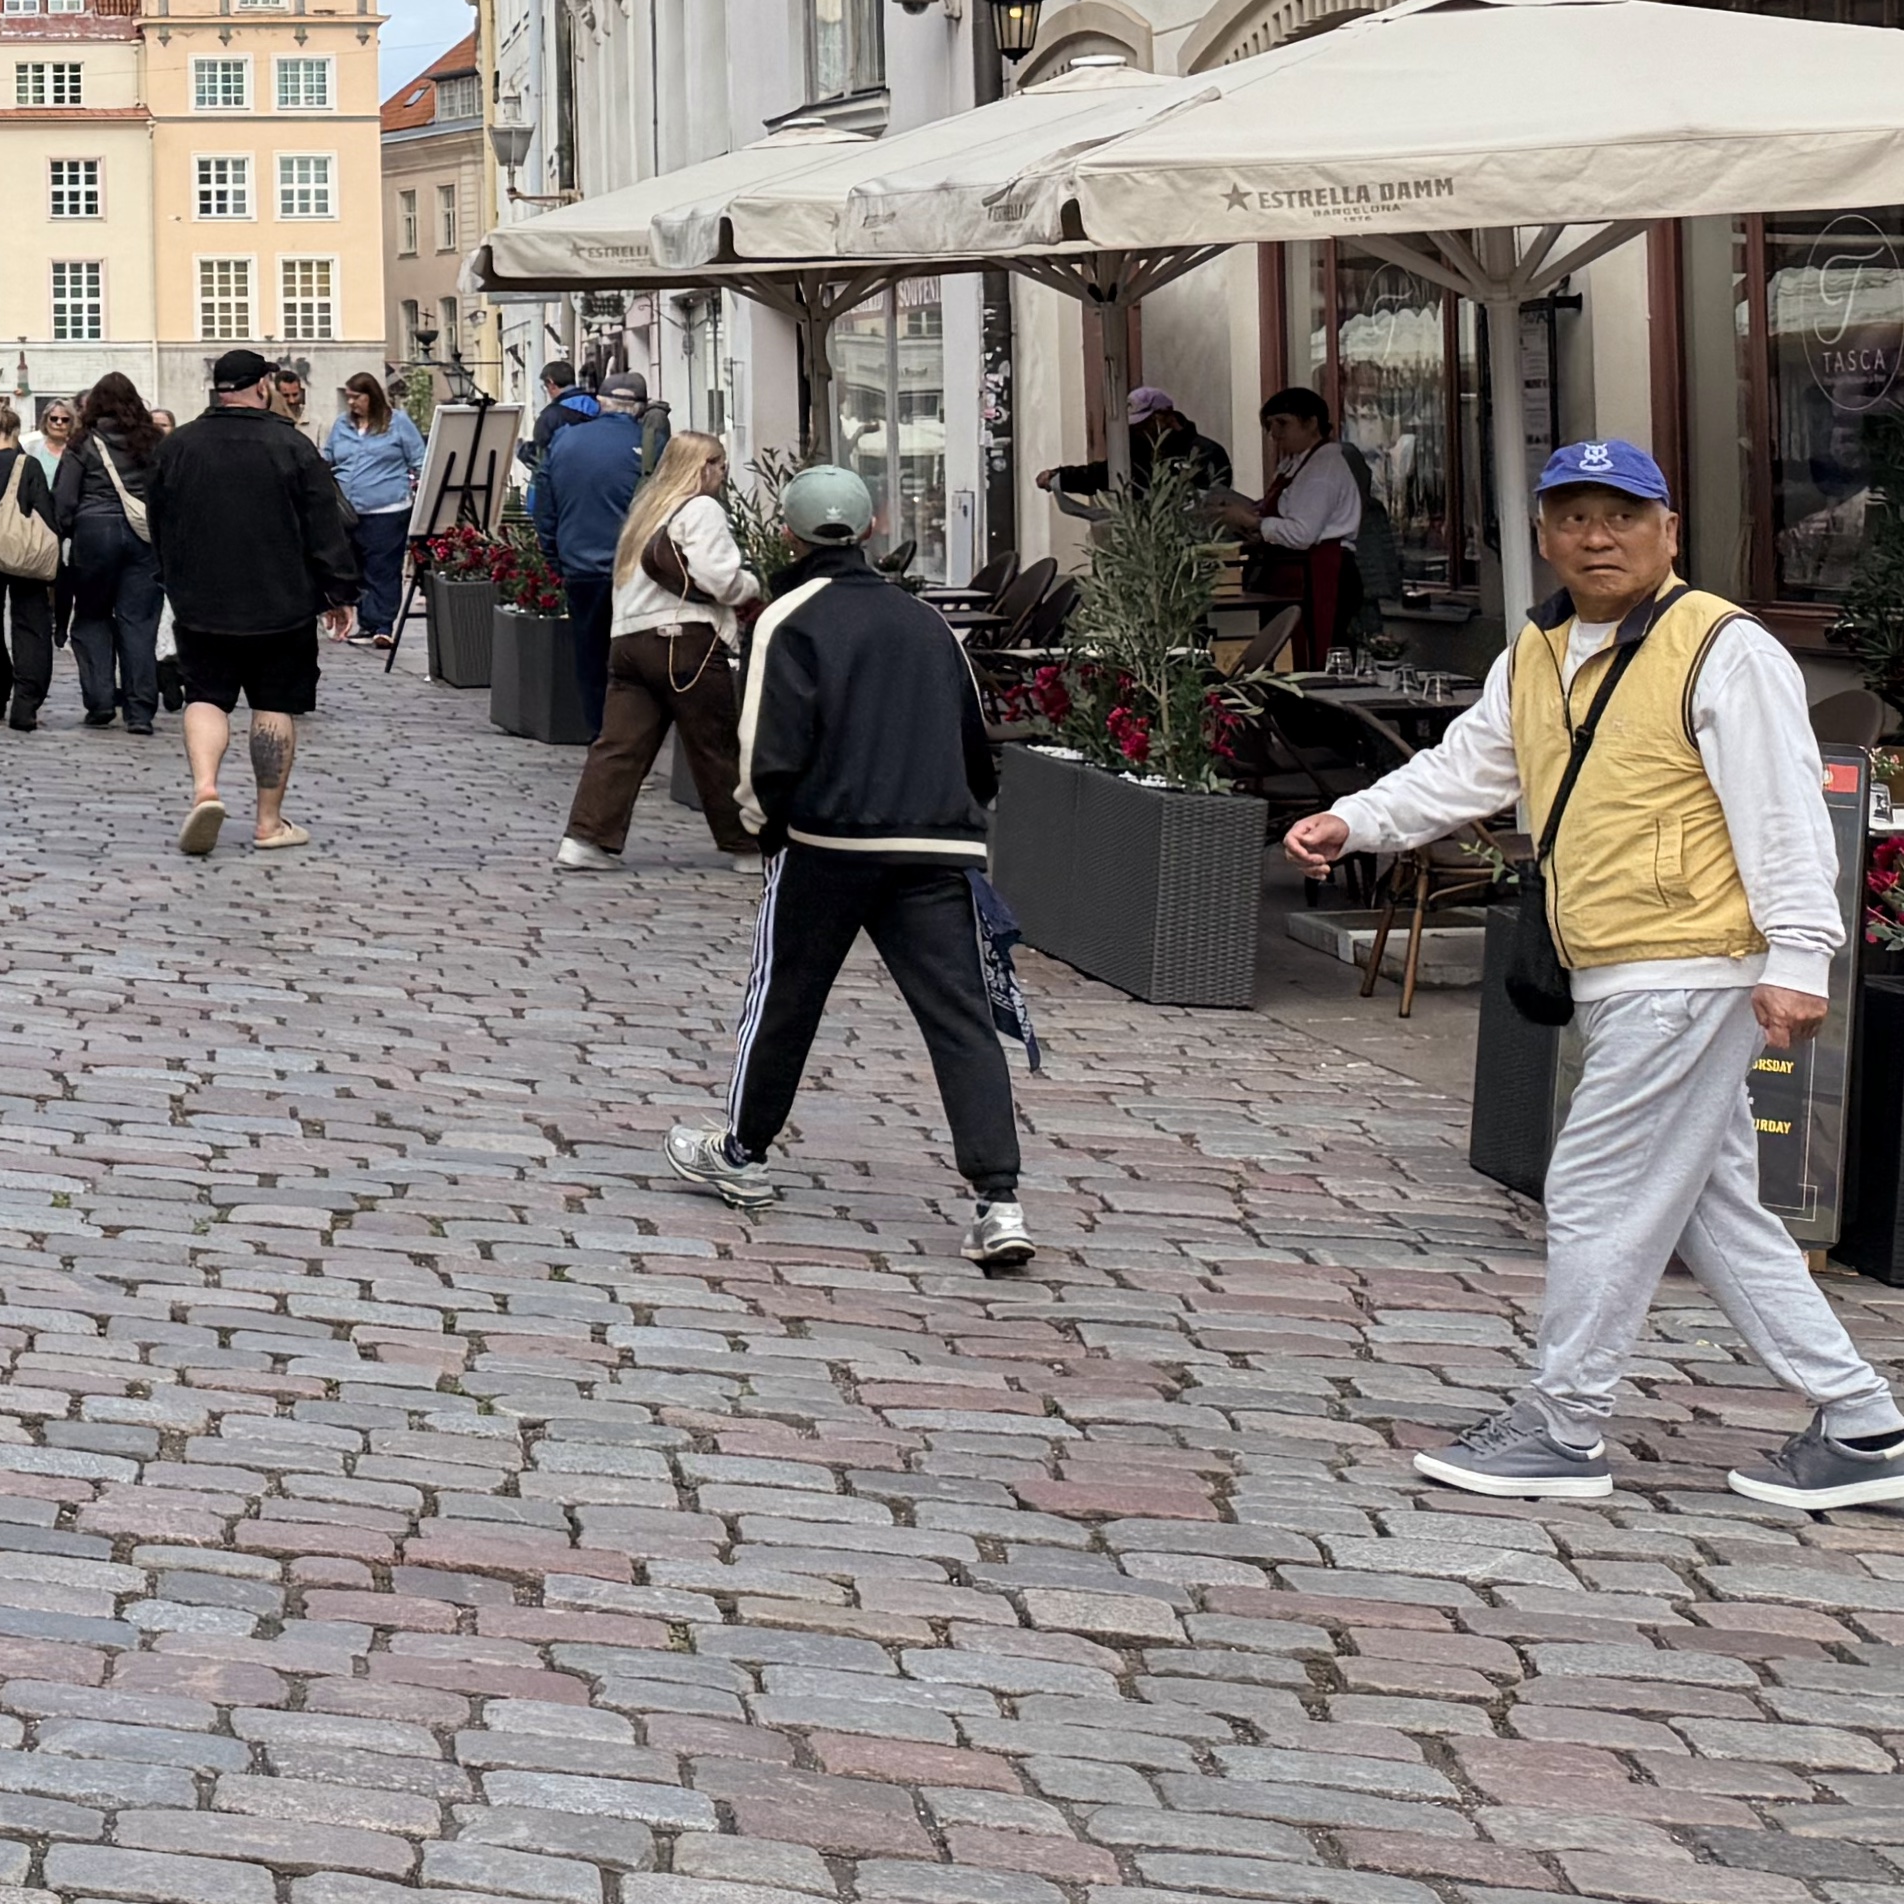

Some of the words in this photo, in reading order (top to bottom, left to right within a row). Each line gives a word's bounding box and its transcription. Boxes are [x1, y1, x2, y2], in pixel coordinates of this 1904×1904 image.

[1258, 185, 1372, 209] ESTRELLA
[1379, 177, 1455, 202] DAMM
[1312, 203, 1402, 217] BARCELONA
[1823, 349, 1886, 373] TASCA
